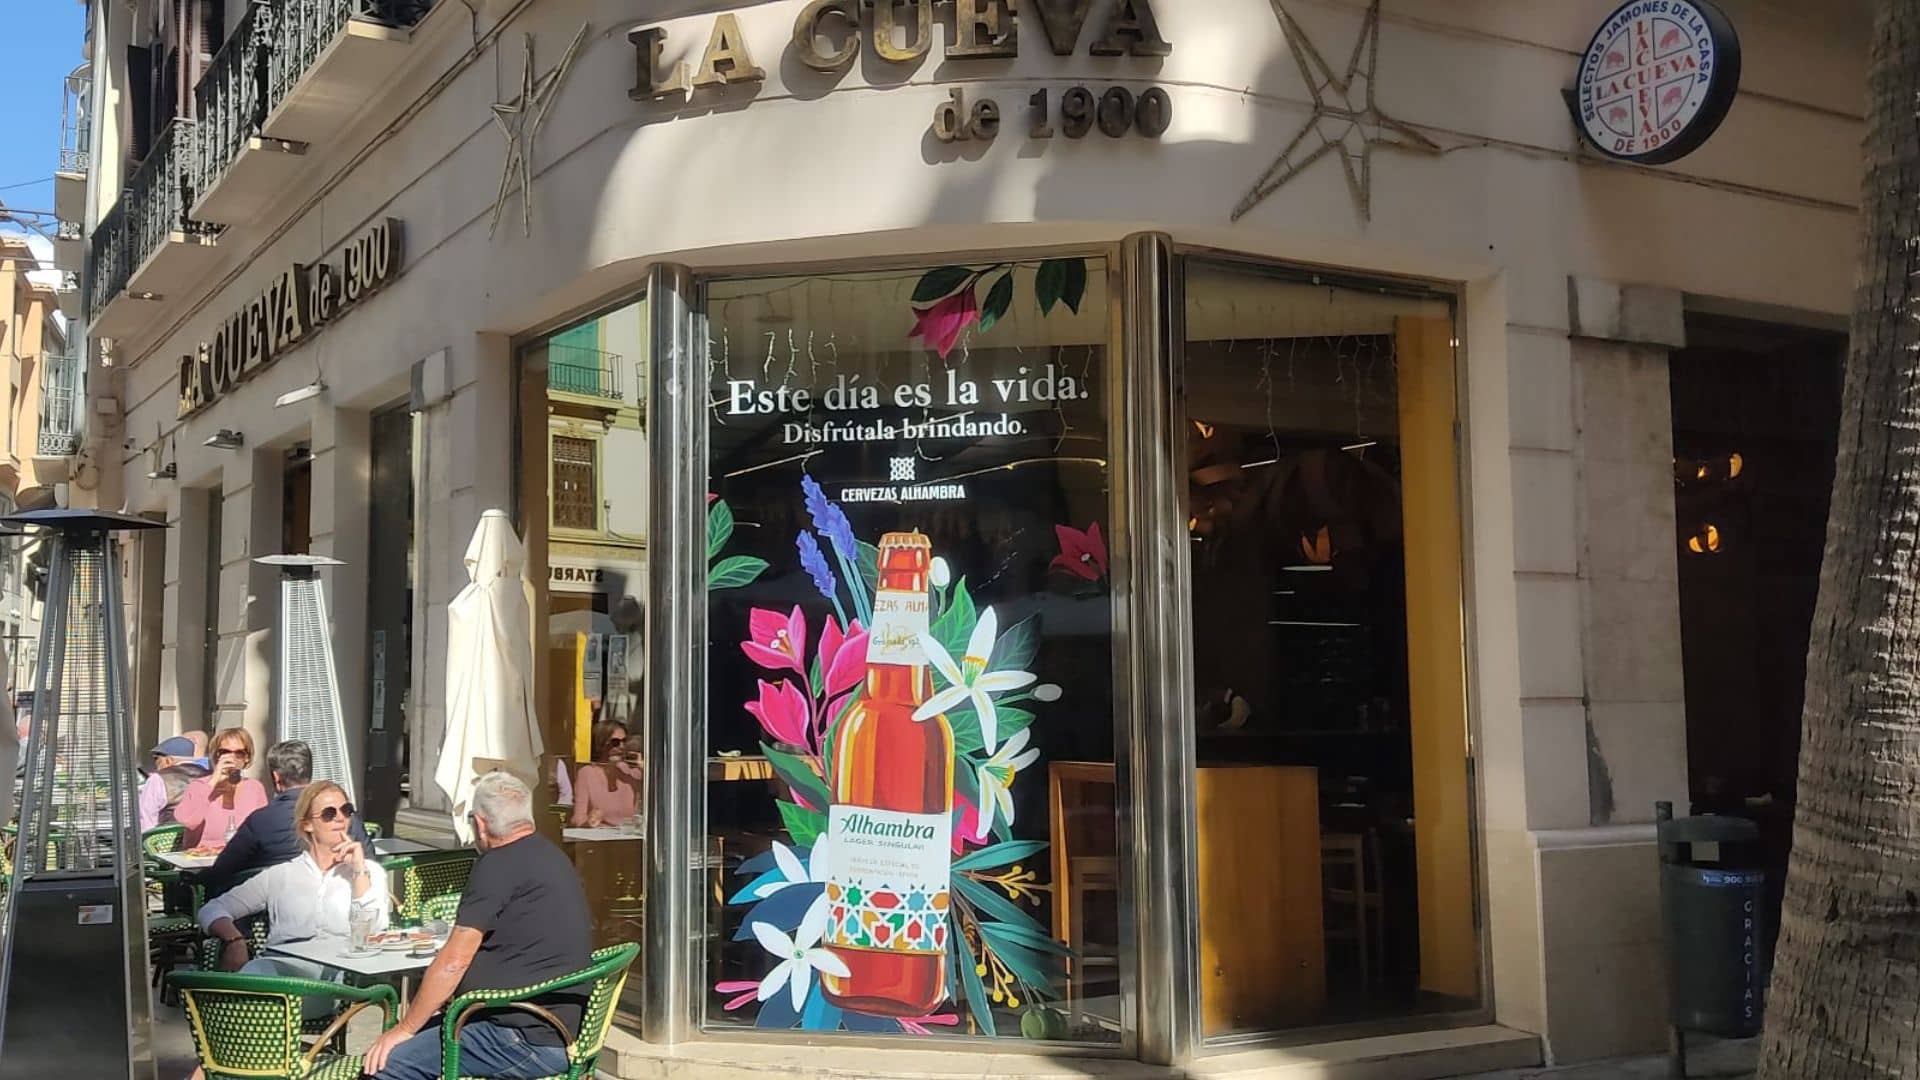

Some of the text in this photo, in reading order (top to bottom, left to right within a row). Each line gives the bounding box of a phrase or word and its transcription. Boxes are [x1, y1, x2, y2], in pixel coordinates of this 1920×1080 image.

[627, 0, 1172, 100] LA CUEVA
[1582, 1, 1711, 122] SELECTOS JAMONES DE LA CASA
[1596, 54, 1696, 101] LA CUEVA
[934, 86, 1173, 142] de 1900
[1613, 119, 1682, 153] DE 1900
[176, 217, 392, 421] LA CUEVA de 1900
[726, 364, 1089, 415] Este día es la vida.
[783, 413, 1028, 444] Disfrútala brindando.
[841, 485, 966, 502] CERVEZAS ALHAMBRA
[841, 813, 935, 840] Alhambra
[1743, 900, 1754, 1018] GRACIAS
